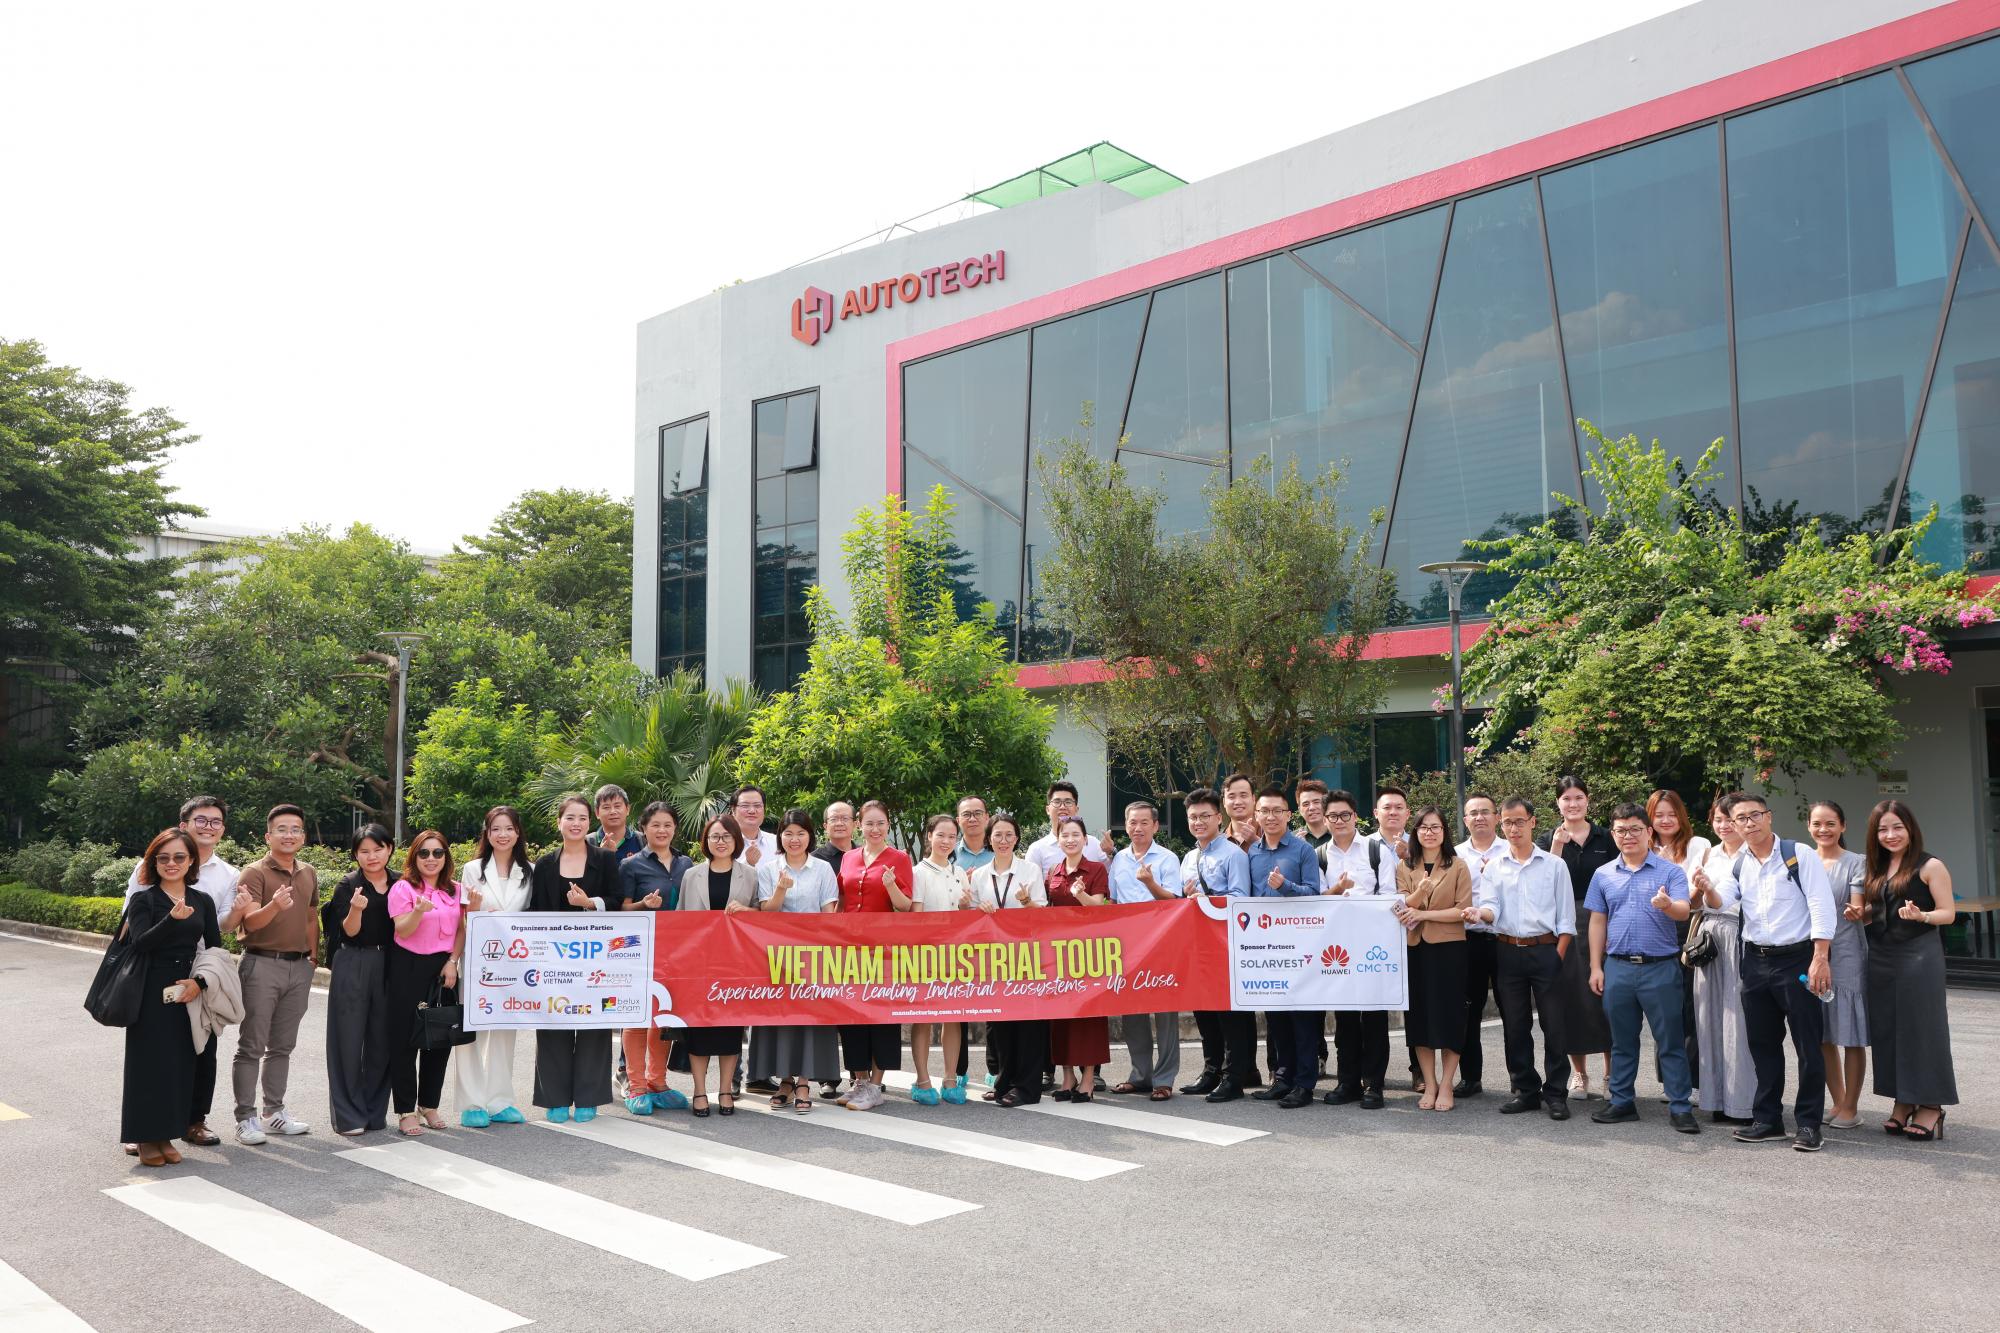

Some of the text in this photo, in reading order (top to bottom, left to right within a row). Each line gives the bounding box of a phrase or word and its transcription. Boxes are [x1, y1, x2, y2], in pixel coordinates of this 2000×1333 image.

[840, 250, 1005, 320] AUTOTECH
[1275, 917, 1325, 925] AUTOTECH
[548, 941, 603, 959] VSIP
[767, 937, 1123, 985] VIETNAM INDUSTRIAL TOUR
[1240, 959, 1305, 968] SOLARVEST
[1356, 963, 1398, 973] CMC TS
[707, 981, 784, 1004] Experience
[790, 980, 856, 1001] Vietnam's
[862, 980, 919, 1003] Leading
[923, 977, 998, 1000] Industrial
[1003, 977, 1087, 997] Ecosystems
[1106, 974, 1127, 994] Up
[1132, 970, 1178, 990] Close.
[1242, 980, 1289, 990] VIVOTEK
[616, 1004, 641, 1012] cham
